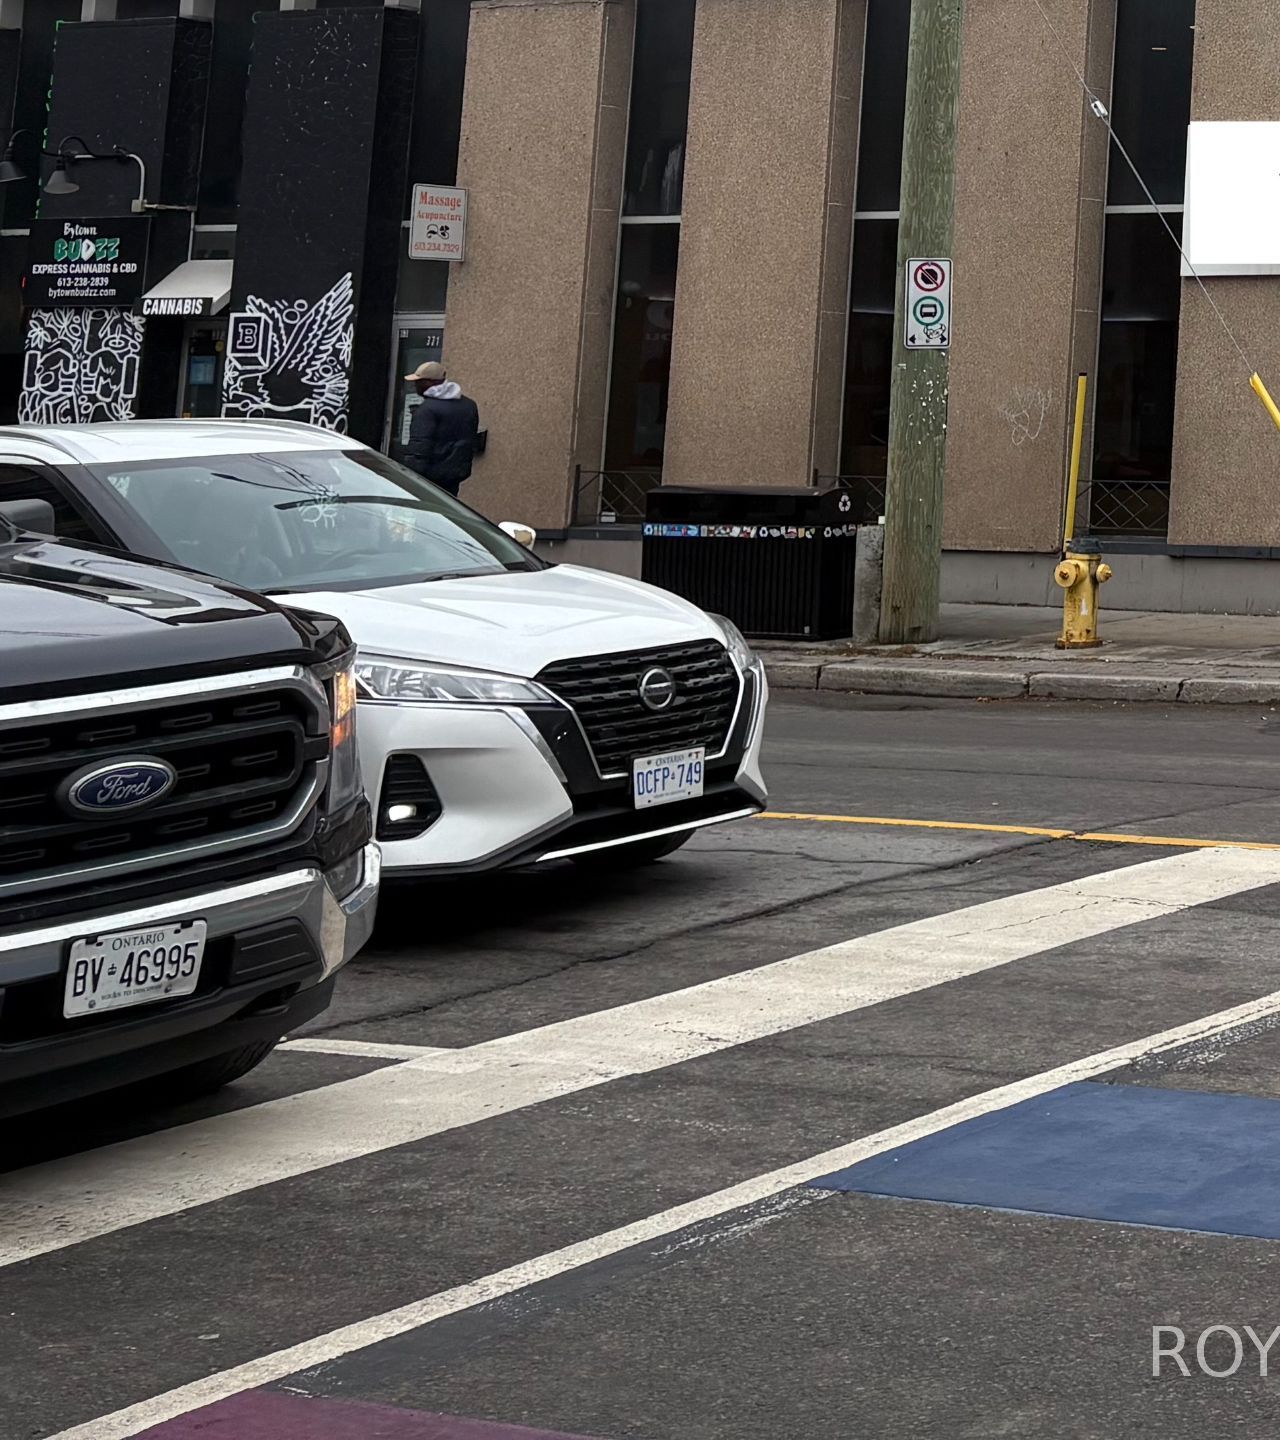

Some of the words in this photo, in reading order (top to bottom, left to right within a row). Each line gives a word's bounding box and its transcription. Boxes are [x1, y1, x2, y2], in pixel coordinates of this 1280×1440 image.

[419, 191, 463, 211] Massage
[63, 222, 98, 238] Bytown
[54, 237, 121, 262] BUDZZ
[32, 264, 69, 274] EXPRESS
[69, 263, 112, 273] CANNABIS
[119, 263, 137, 273] CBD
[48, 288, 117, 299] bytownbudzz.com
[142, 298, 203, 315] CANNABIS
[96, 772, 153, 803] Ford
[636, 767, 670, 796] DCFP
[677, 761, 702, 789] 749
[111, 932, 165, 951] ONTARIO
[72, 956, 105, 997] BV
[118, 942, 199, 988] 46995
